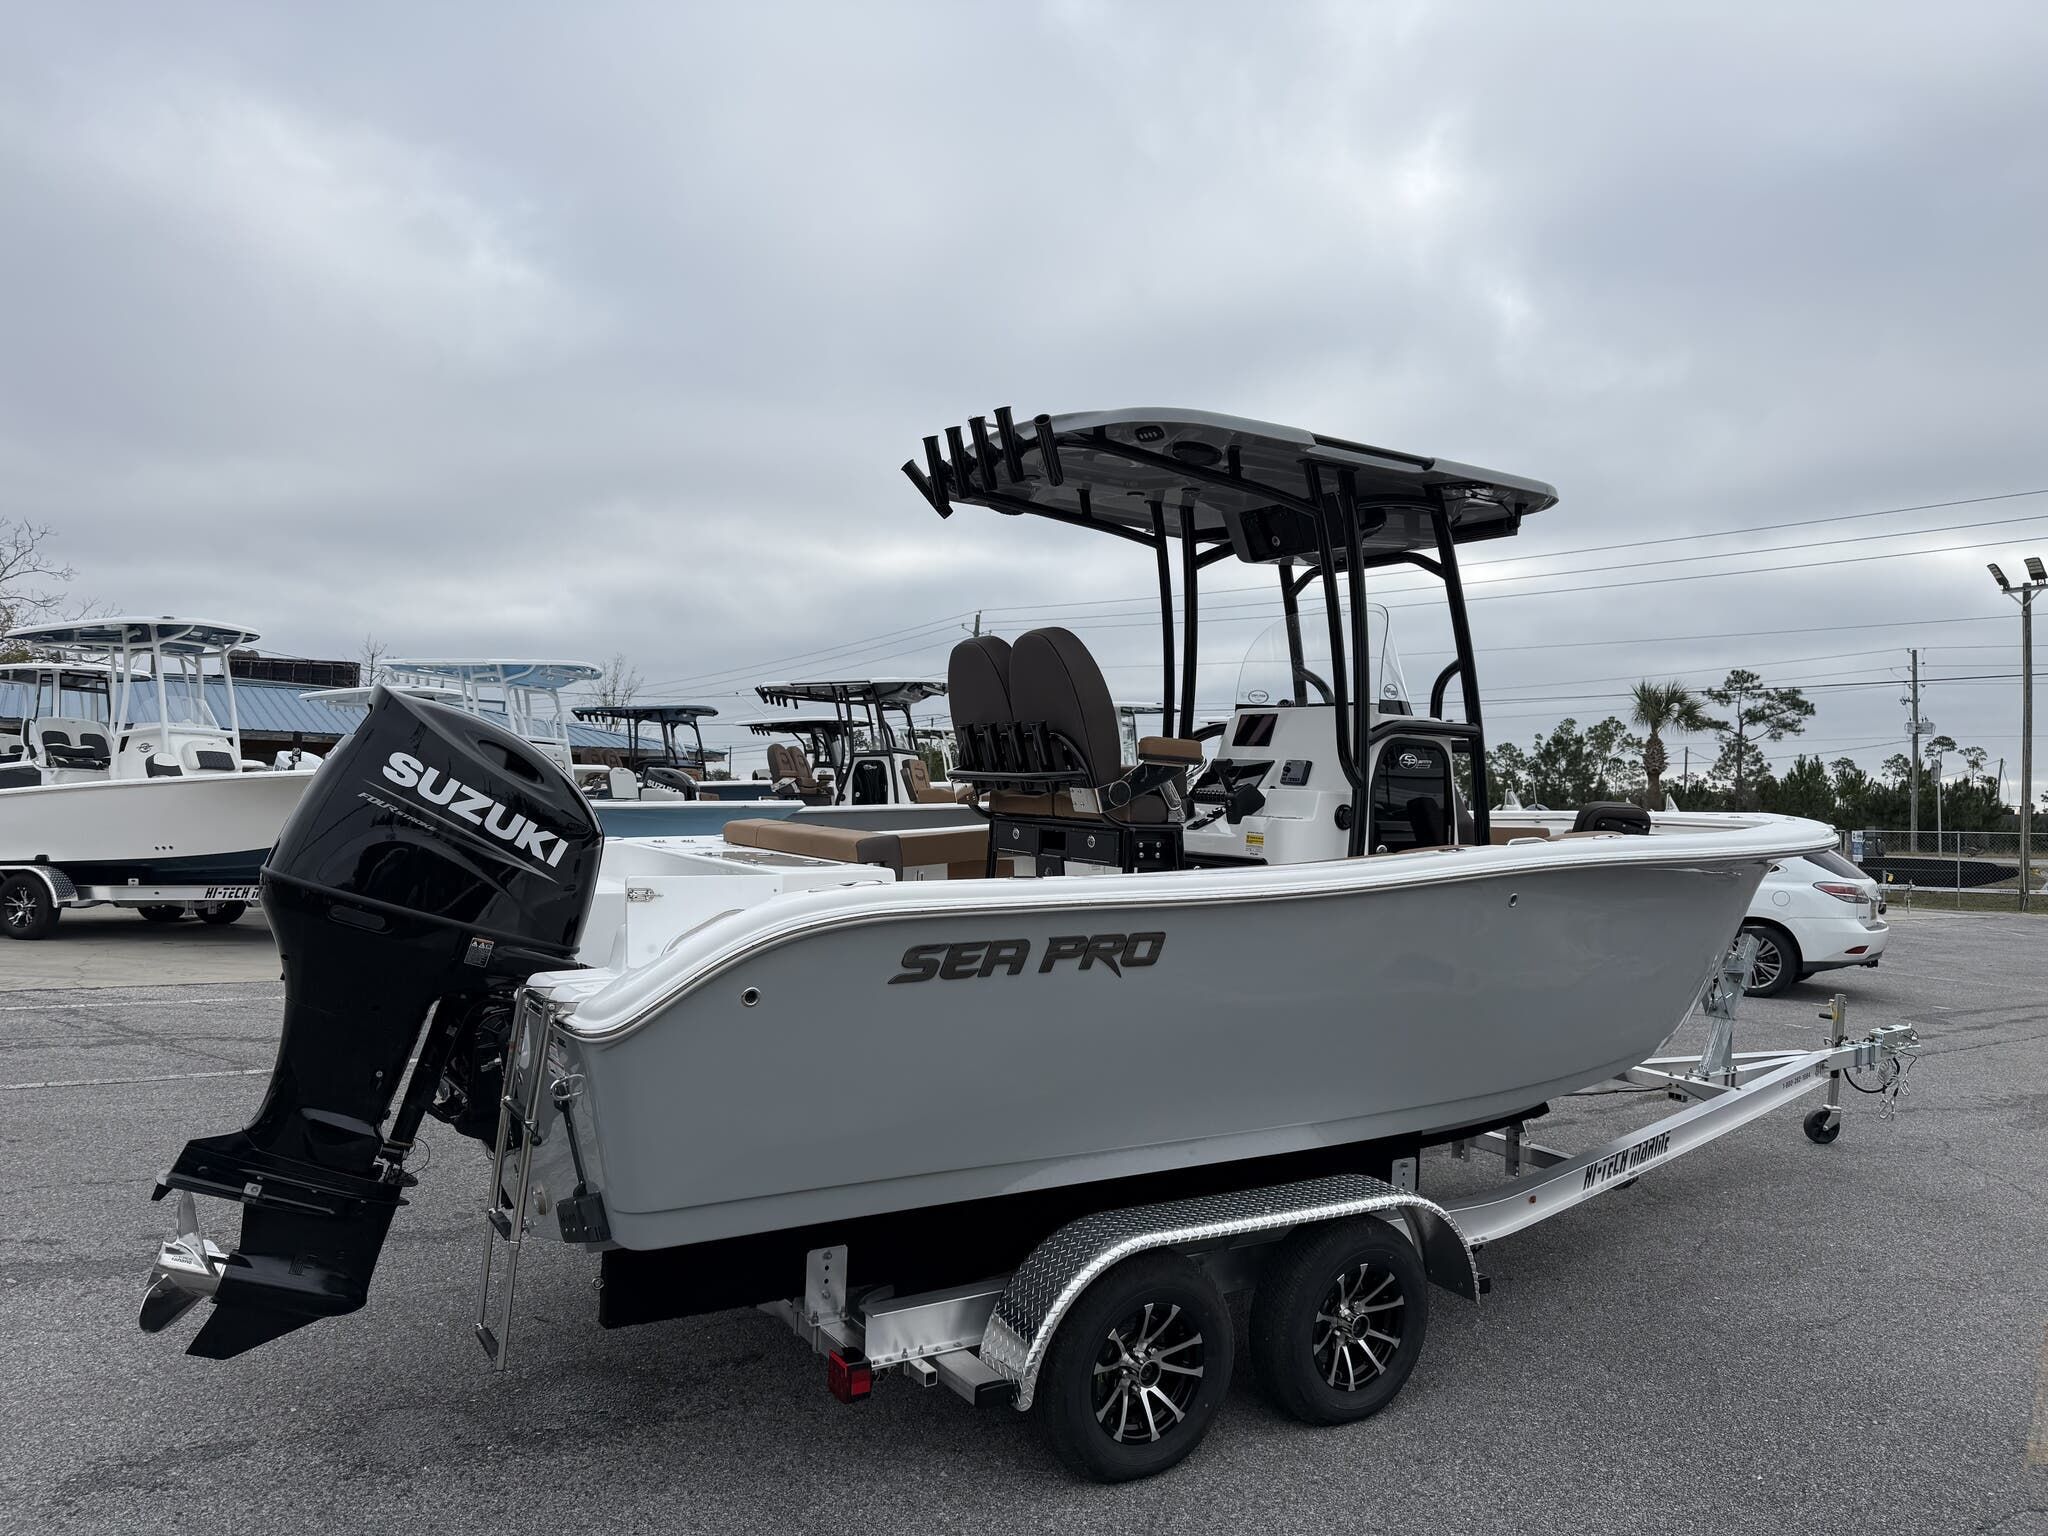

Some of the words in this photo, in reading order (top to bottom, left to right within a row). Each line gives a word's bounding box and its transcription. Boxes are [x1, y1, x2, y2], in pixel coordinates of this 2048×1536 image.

[382, 752, 569, 868] SUZUKI
[204, 887, 250, 899] HI-TECH
[887, 938, 1031, 985] SEA
[1038, 931, 1167, 979] PRO
[1582, 1149, 1630, 1191] HI-TECH
[1629, 1130, 1672, 1170] MARINE
